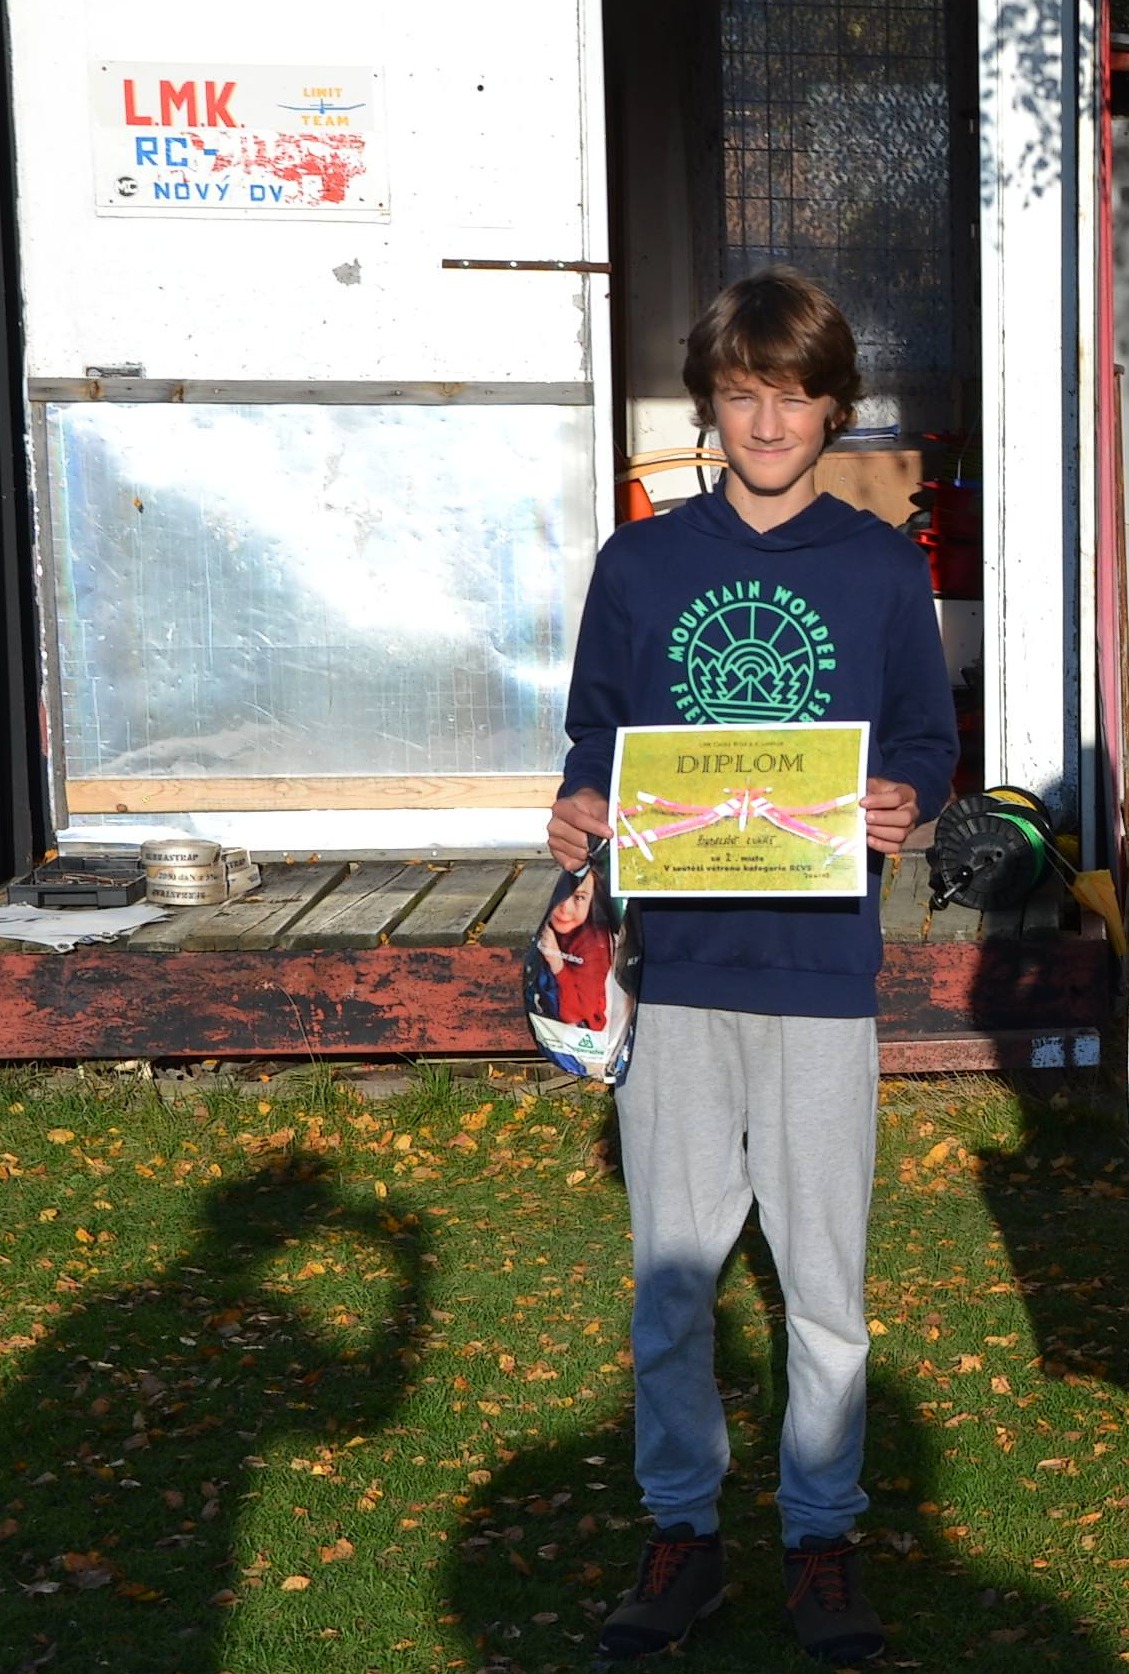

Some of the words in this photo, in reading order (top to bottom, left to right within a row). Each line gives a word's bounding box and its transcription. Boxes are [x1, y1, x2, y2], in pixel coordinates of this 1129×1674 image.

[302, 87, 343, 98] LIMIT
[301, 115, 350, 127] TEAM
[154, 175, 230, 201] NOVÝ
[667, 580, 760, 663] MOUNTAIN
[773, 585, 837, 670] WONDER
[676, 753, 805, 774] DIPLOM
